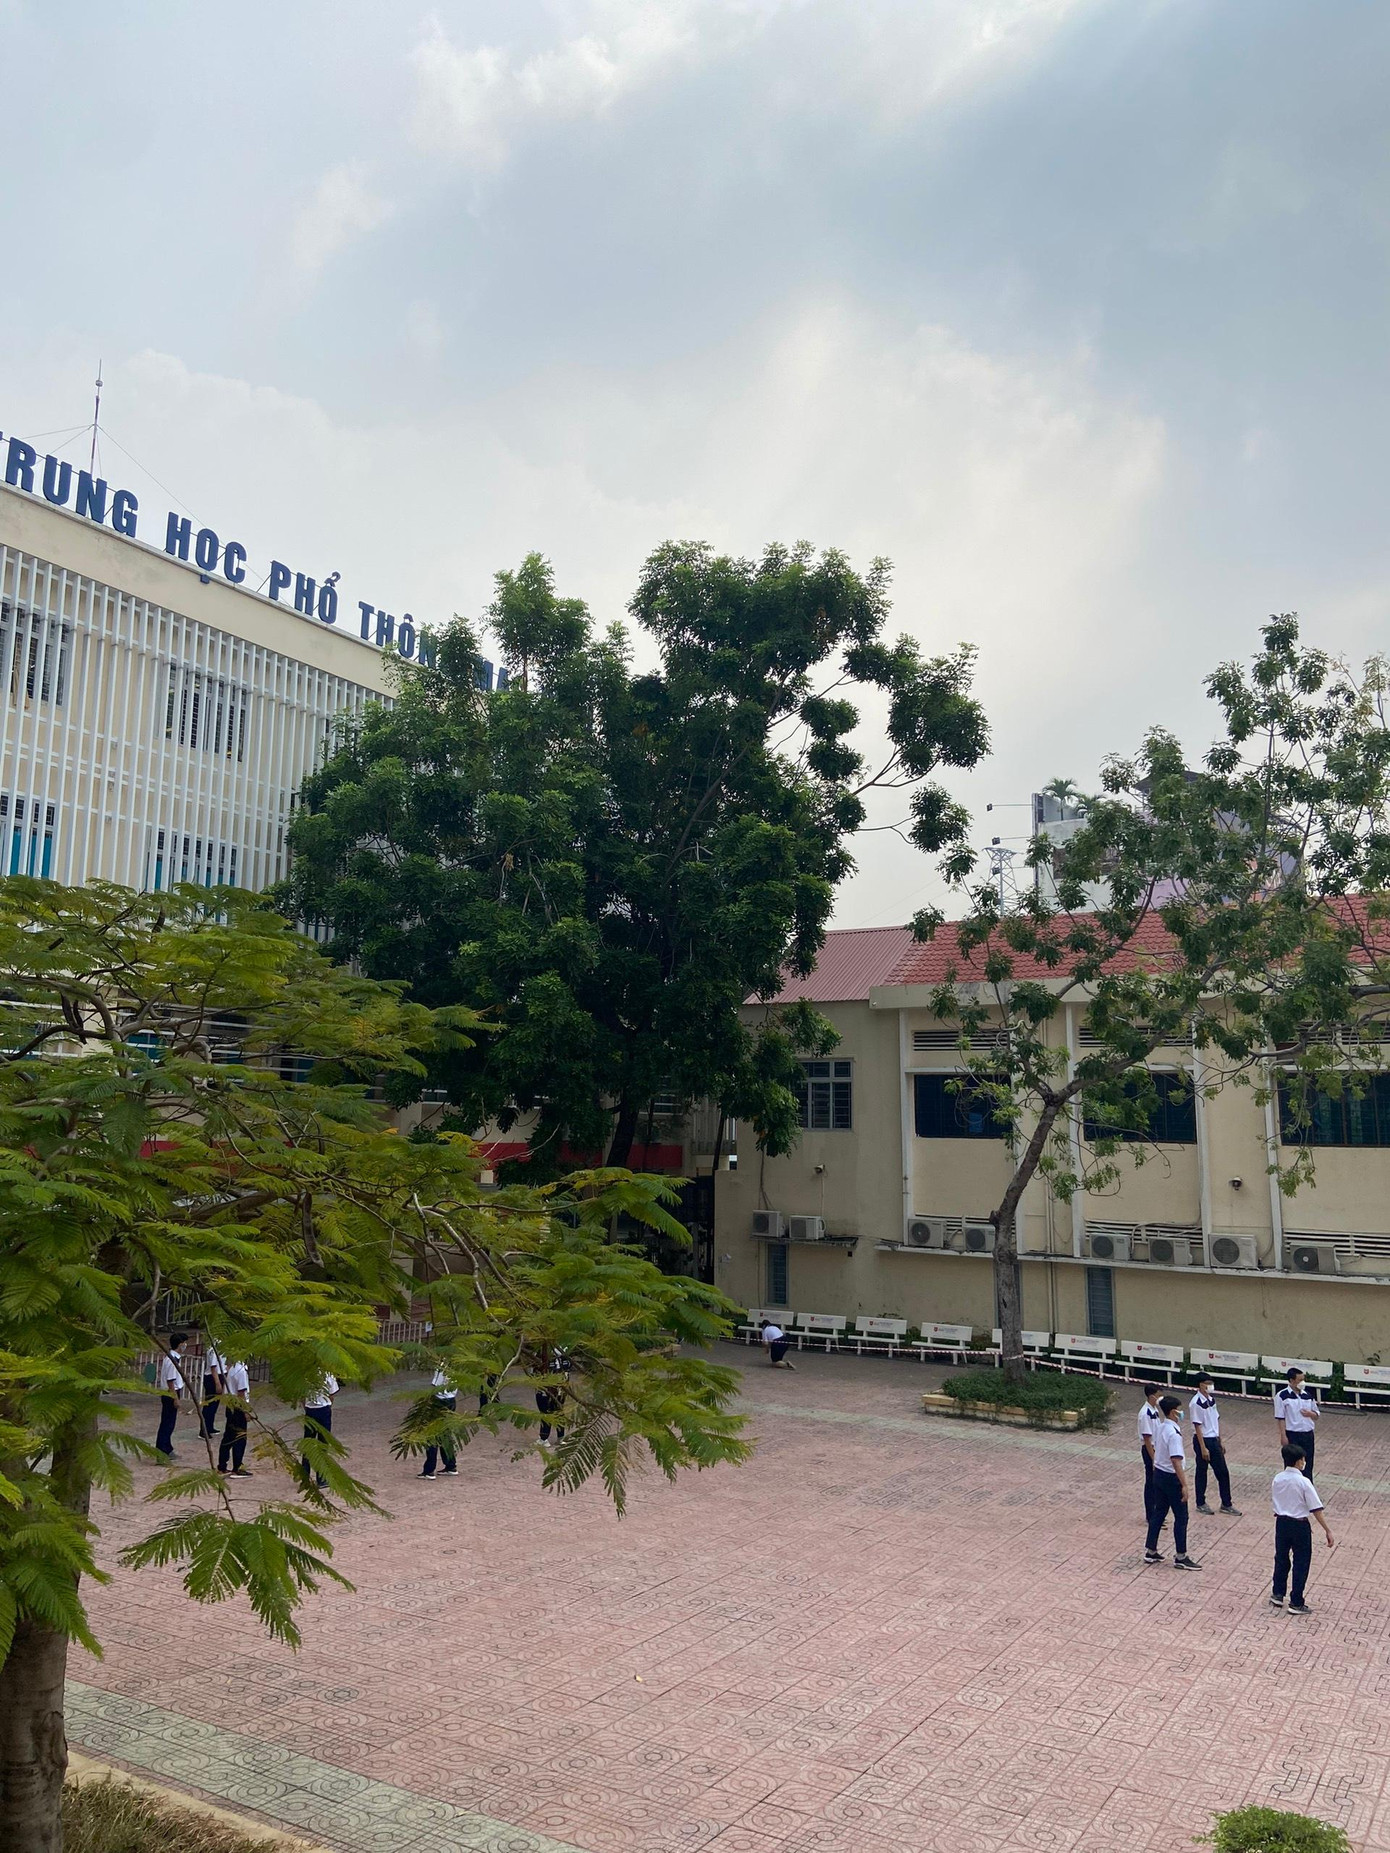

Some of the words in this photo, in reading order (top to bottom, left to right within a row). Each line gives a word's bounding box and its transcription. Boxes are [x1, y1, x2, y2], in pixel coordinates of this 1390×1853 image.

[0, 431, 138, 537] RUNG
[165, 511, 247, 584] HỌC
[268, 560, 341, 625] PHỔ
[358, 601, 454, 674] THÔN
